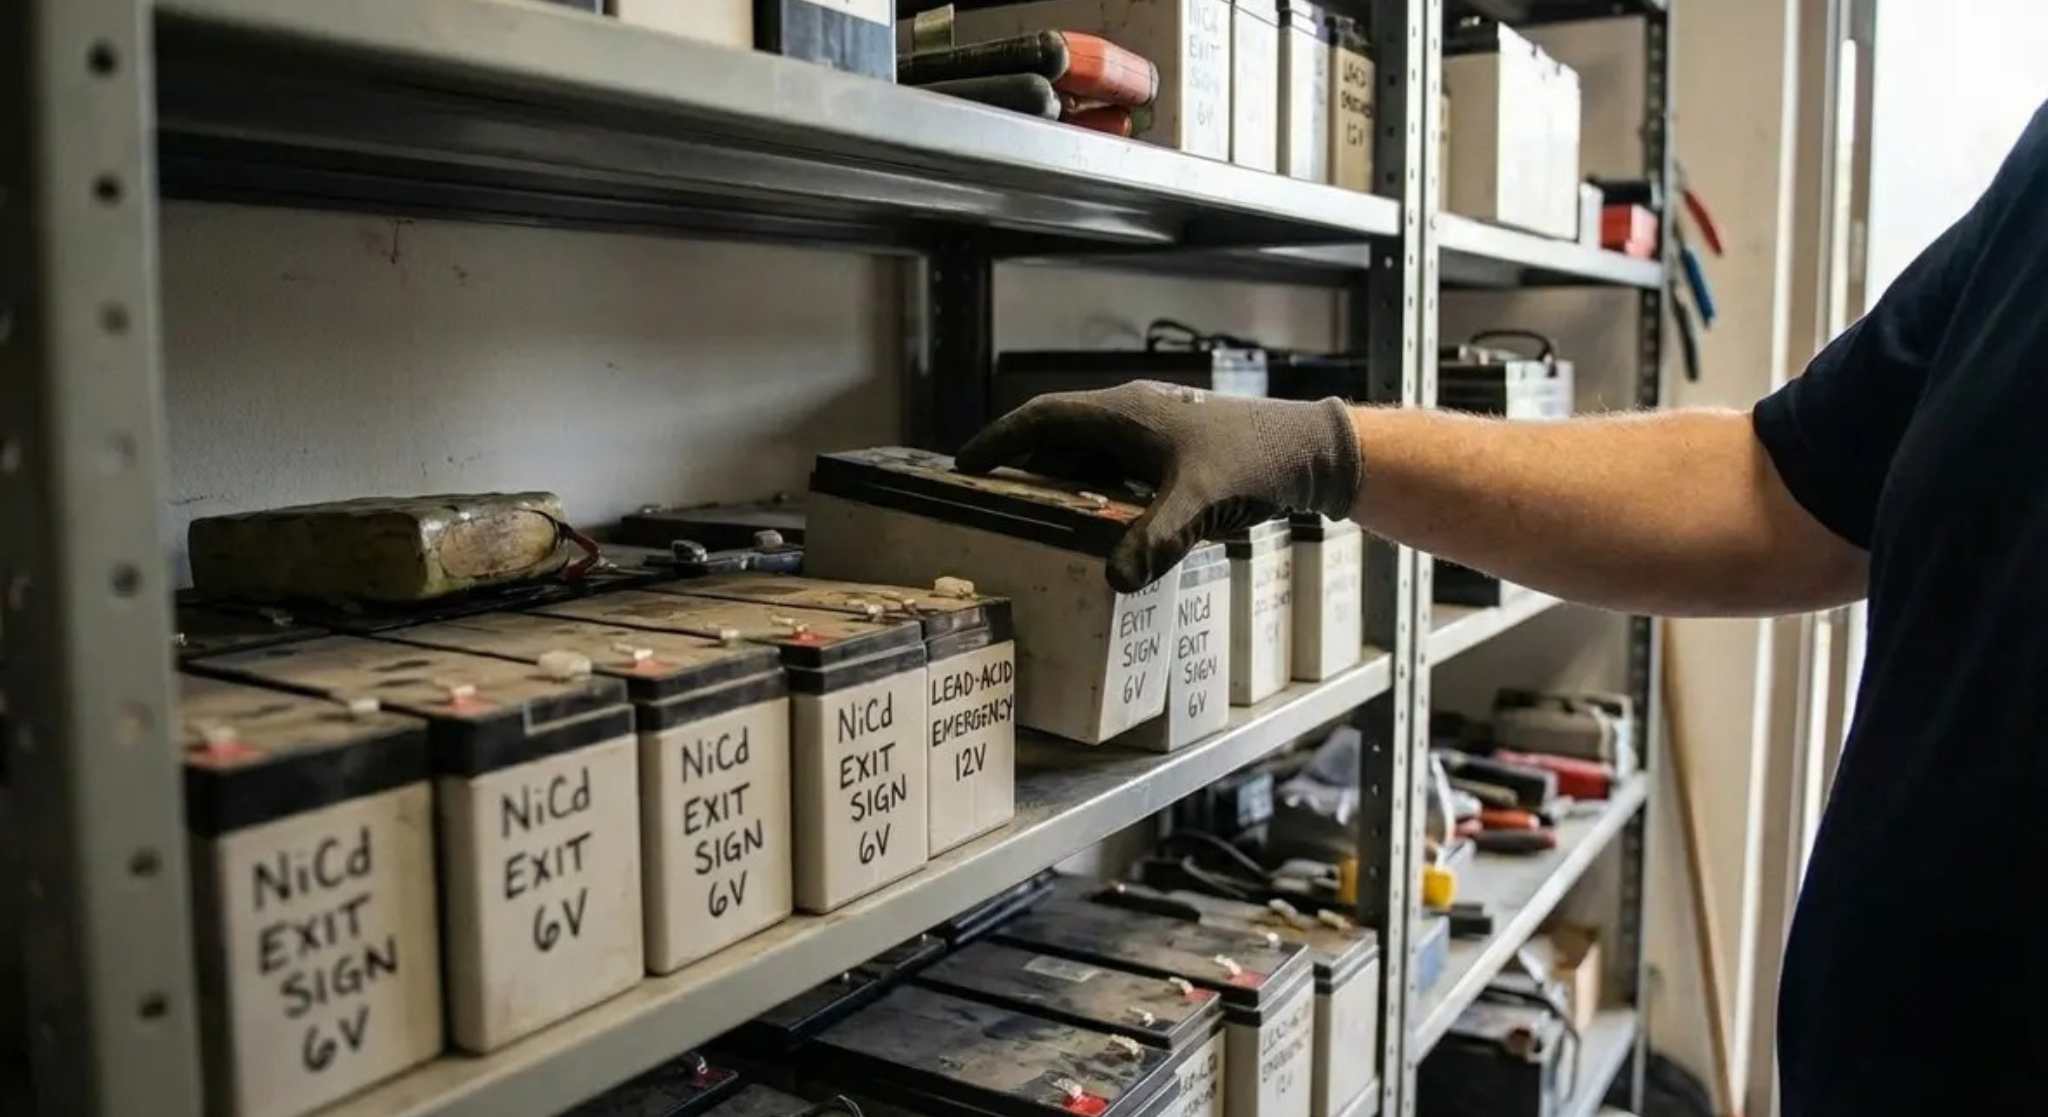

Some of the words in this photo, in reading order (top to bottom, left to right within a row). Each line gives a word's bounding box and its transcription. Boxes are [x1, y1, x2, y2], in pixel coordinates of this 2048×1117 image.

[1122, 635, 1160, 667] SIGN
[1178, 630, 1210, 660] EXIT
[931, 660, 1013, 706] LEAD-ACID
[1123, 671, 1146, 704] 6V
[1188, 690, 1207, 719] 6V
[838, 691, 893, 744] NiCd
[932, 694, 1014, 747] EMERGENCY
[681, 727, 751, 783] NiCd
[840, 742, 896, 790] EXIT
[955, 743, 987, 782] 12V
[501, 768, 590, 838] NiCd
[683, 784, 752, 837] EXIT
[850, 773, 907, 822] SIGN
[253, 827, 372, 911] NiCd
[505, 832, 592, 898] EXIT
[694, 820, 764, 875] SIGN
[859, 823, 891, 865] 6V
[533, 890, 588, 951] 6V
[707, 872, 748, 918] 6V
[258, 895, 371, 976] EXIT
[280, 938, 399, 1020] SIGN
[303, 1006, 370, 1071] 6V
